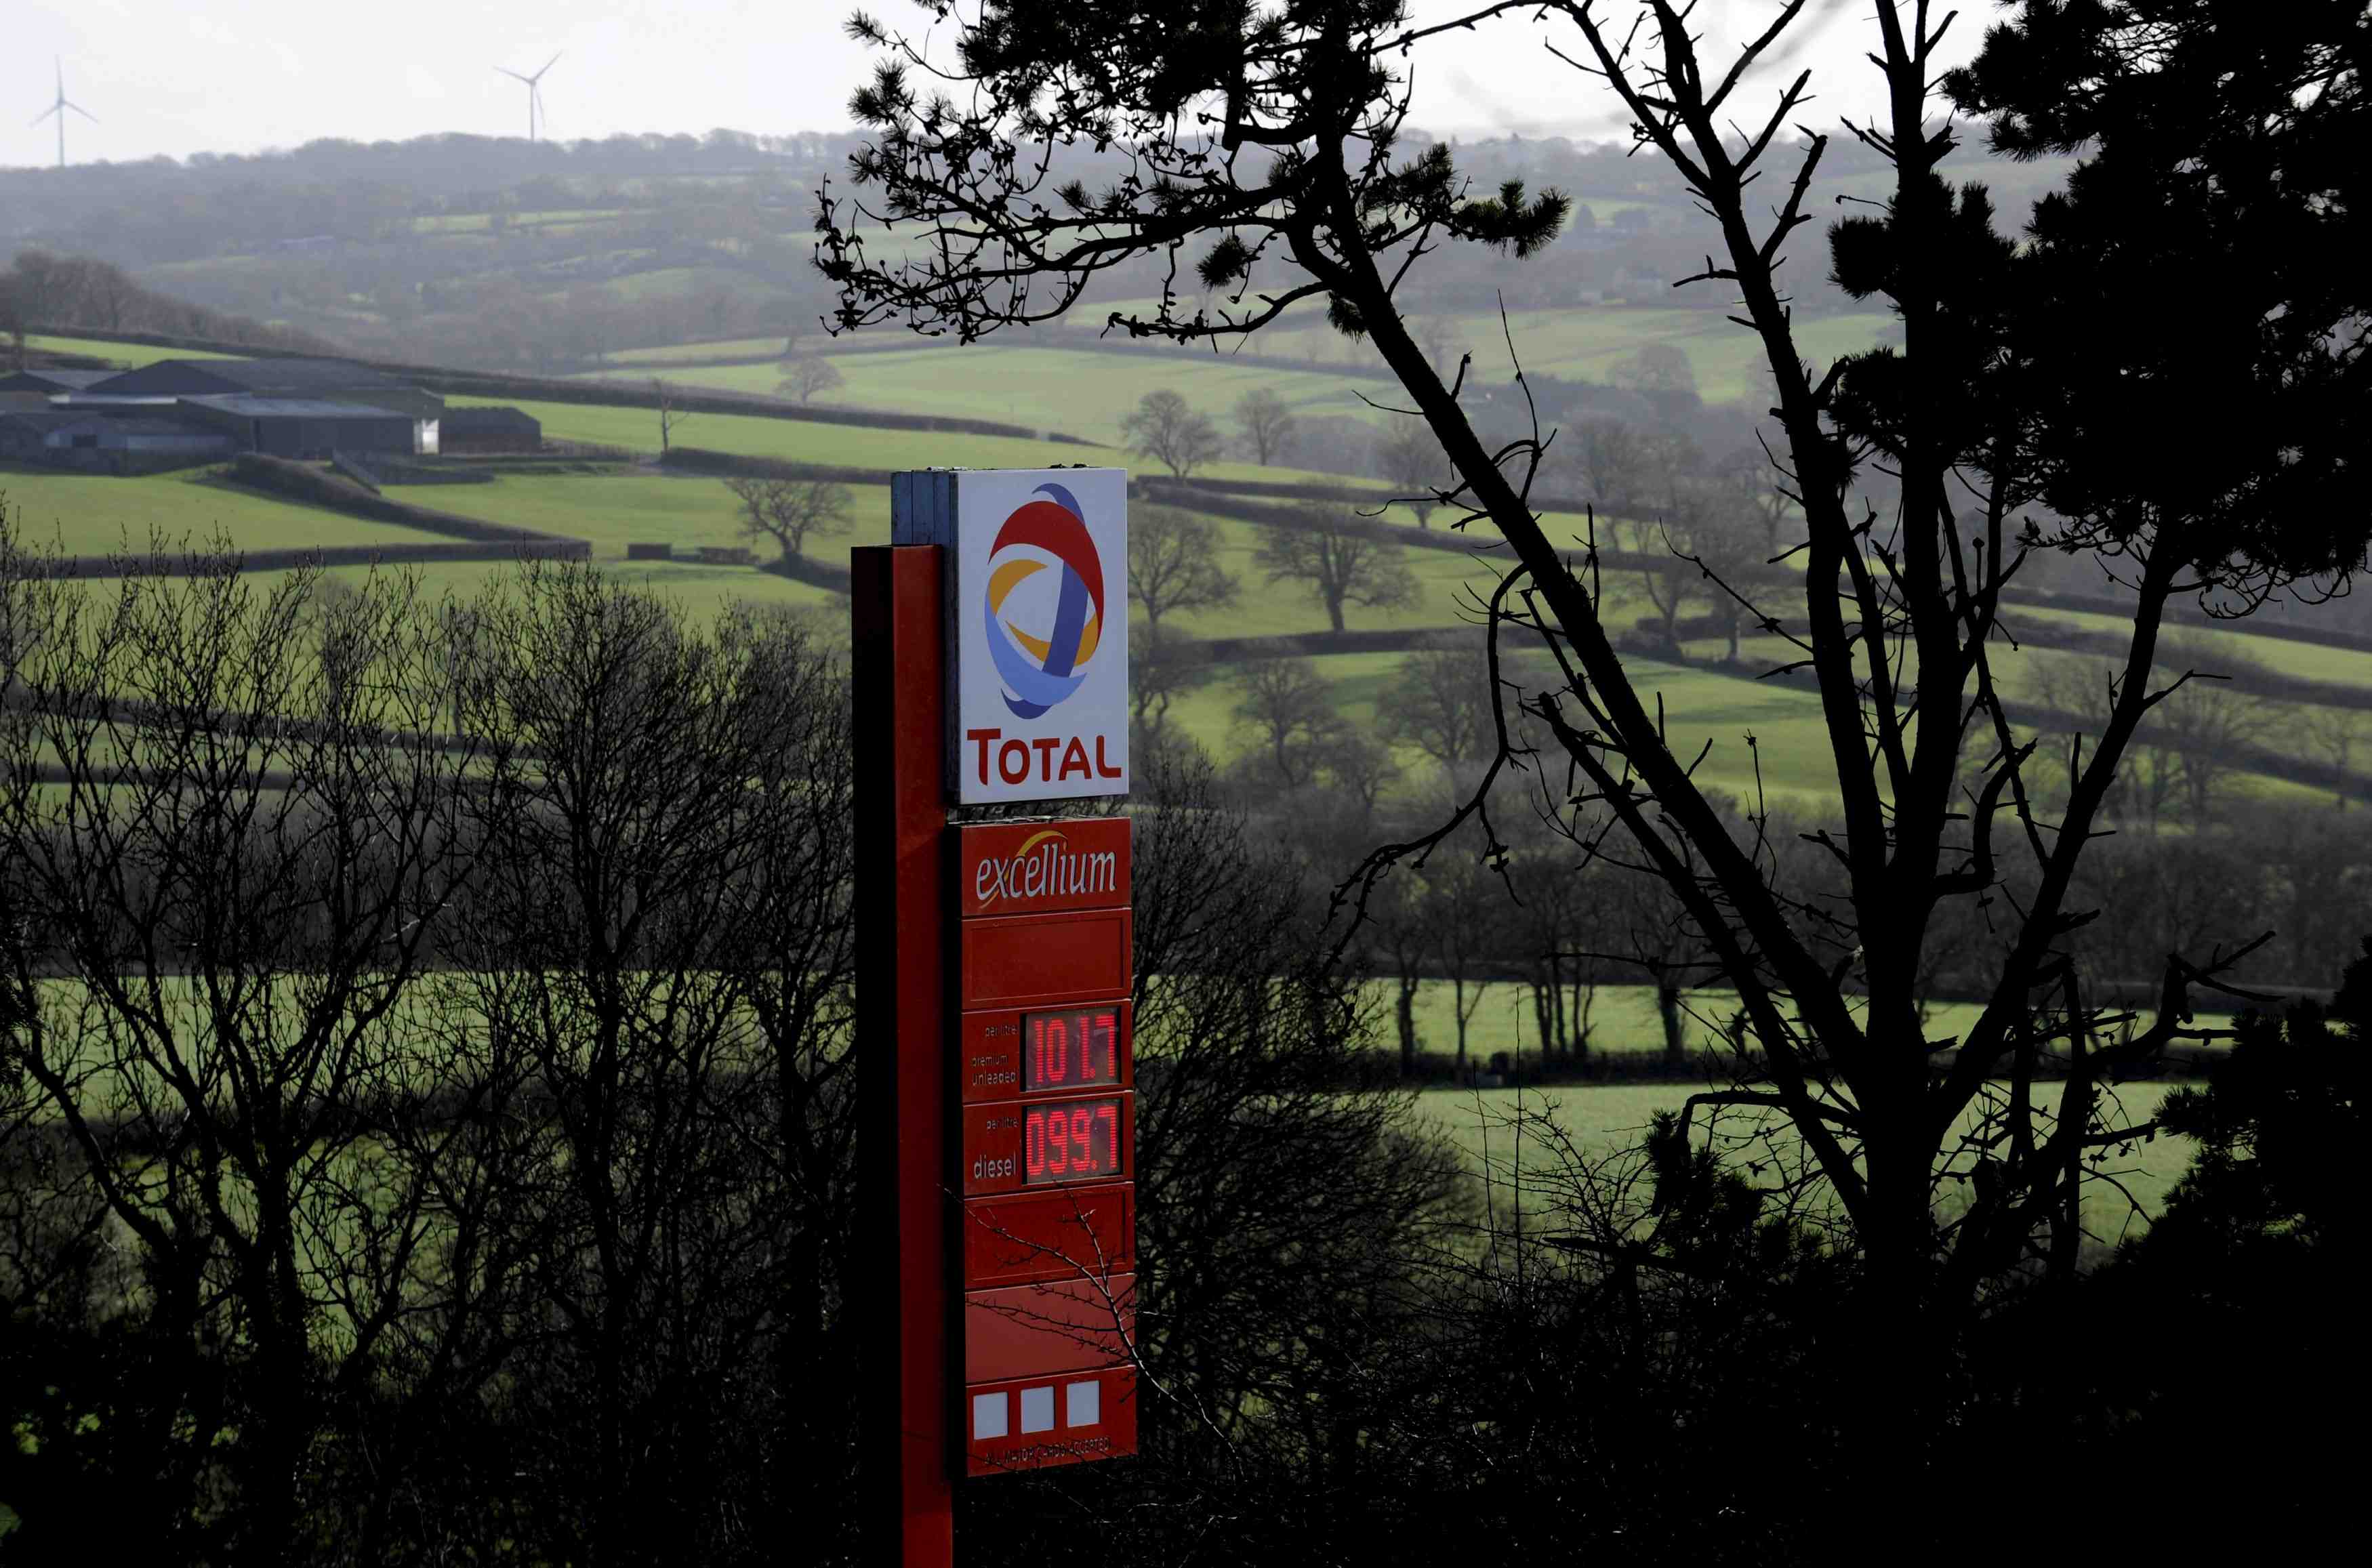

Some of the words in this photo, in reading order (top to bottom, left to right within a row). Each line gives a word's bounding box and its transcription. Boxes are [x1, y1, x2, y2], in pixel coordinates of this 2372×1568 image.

[976, 843, 1116, 901] excellium
[970, 1054, 1008, 1068] premium
[972, 1068, 1017, 1086] unleaded
[1026, 1106, 1117, 1175] 099.7
[974, 1151, 1016, 1179] diesel
